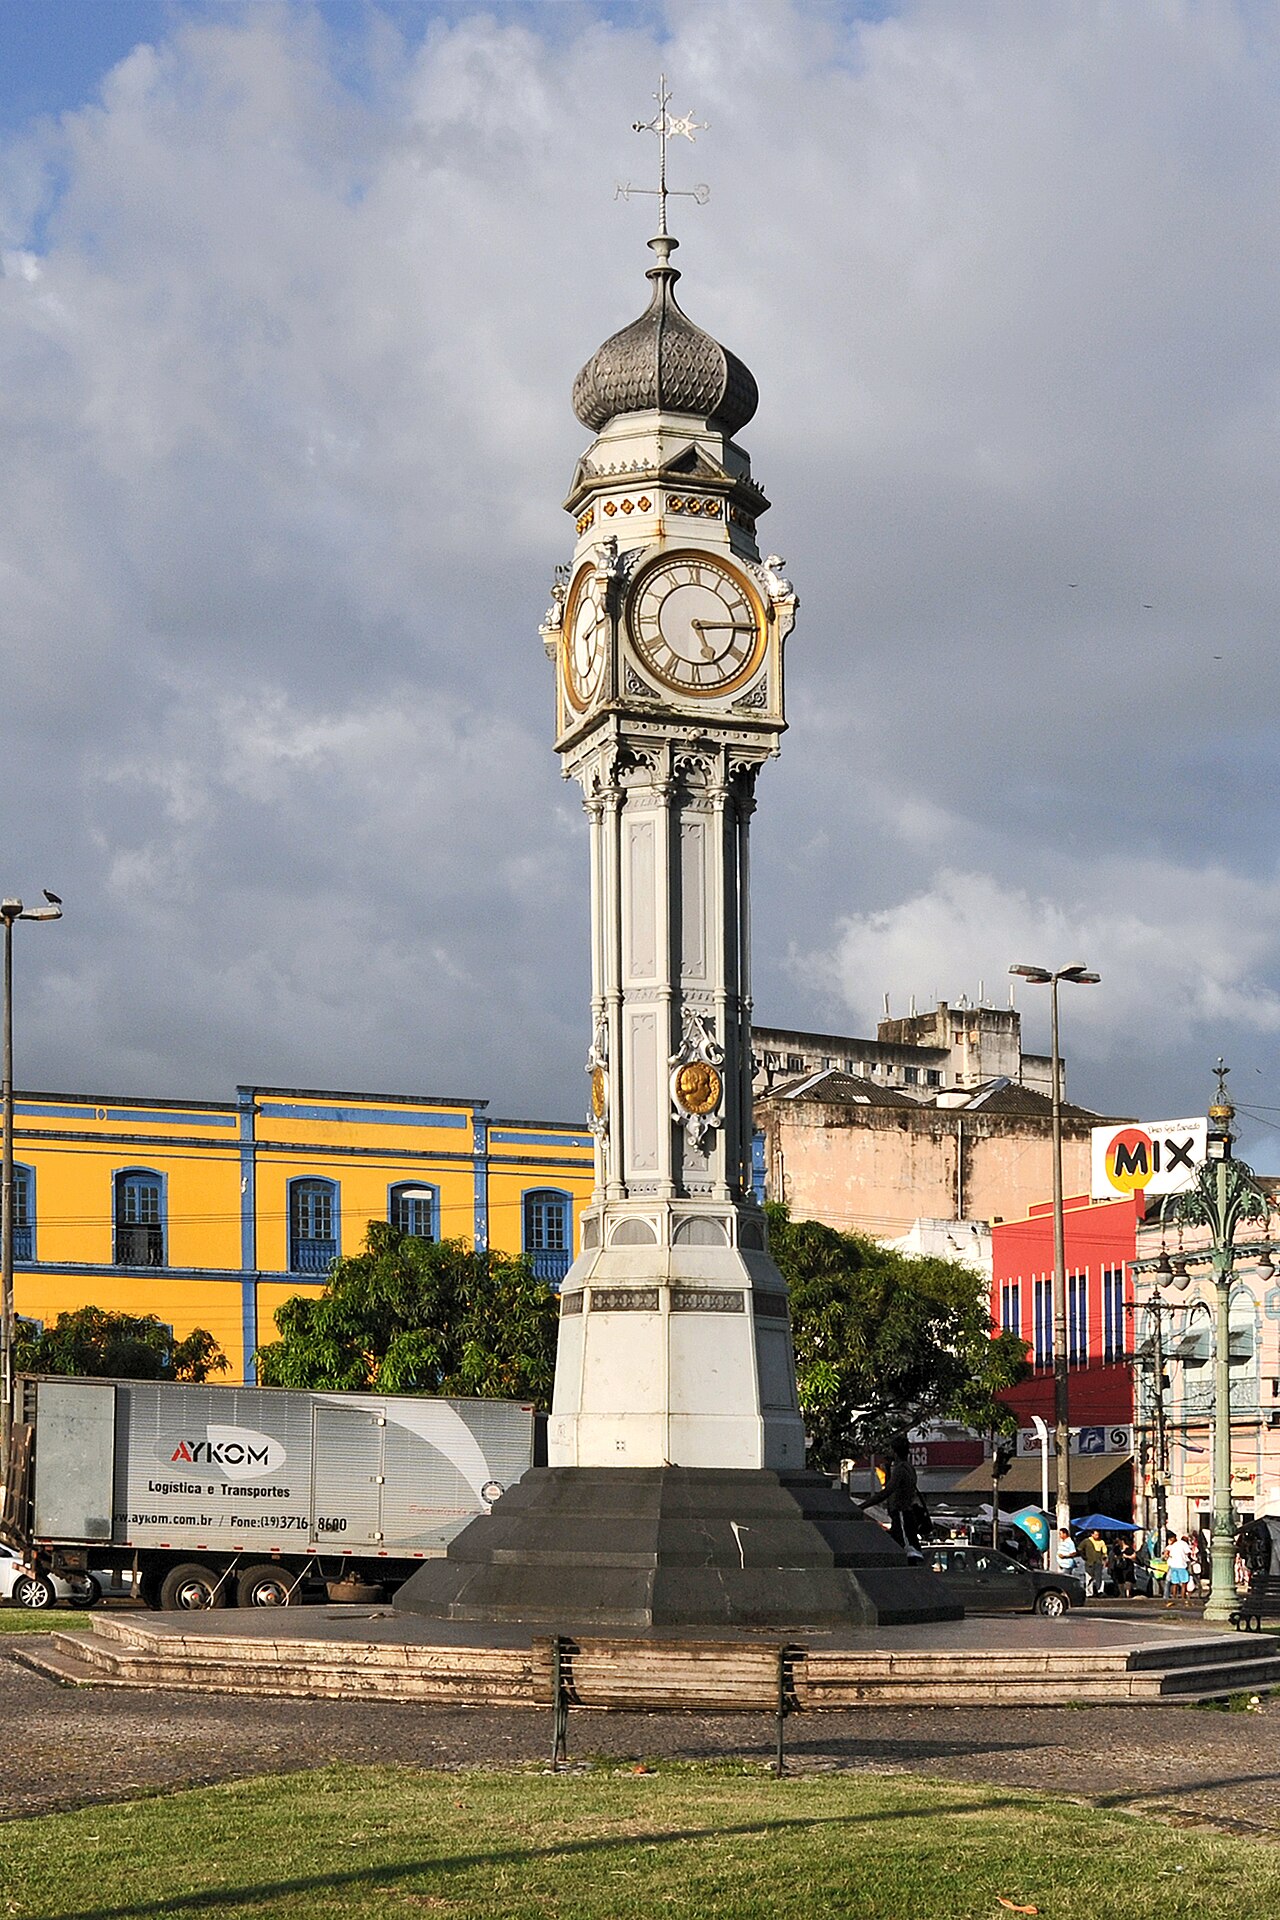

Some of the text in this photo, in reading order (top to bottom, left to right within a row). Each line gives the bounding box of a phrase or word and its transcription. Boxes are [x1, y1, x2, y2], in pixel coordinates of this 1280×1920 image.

[1113, 1137, 1195, 1177] MIX
[171, 1441, 269, 1466] AYKOM
[207, 1485, 215, 1494] e
[221, 1484, 291, 1498] Transportes
[113, 1513, 213, 1526] ww.aykom.com.br
